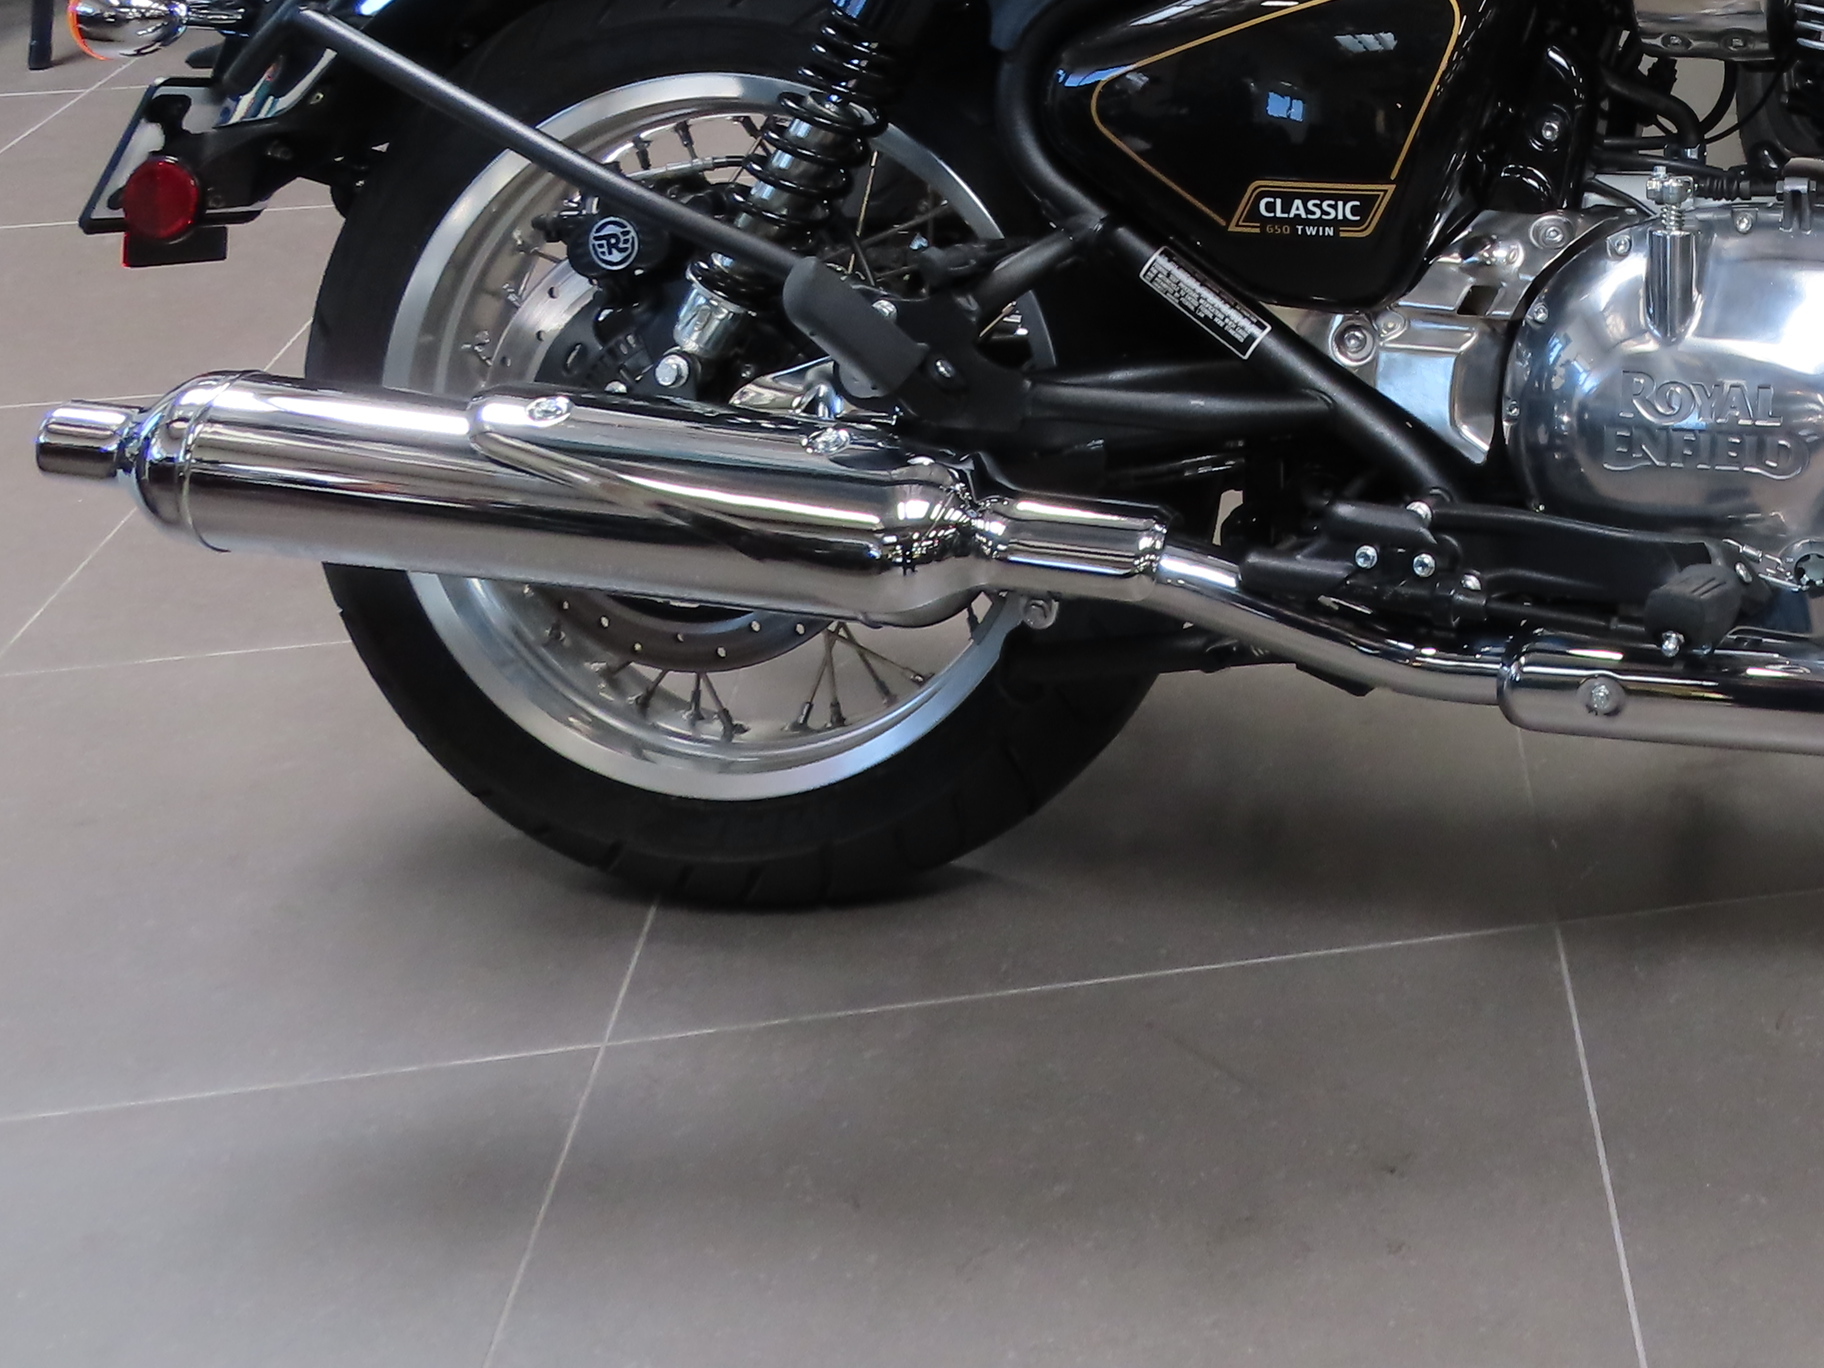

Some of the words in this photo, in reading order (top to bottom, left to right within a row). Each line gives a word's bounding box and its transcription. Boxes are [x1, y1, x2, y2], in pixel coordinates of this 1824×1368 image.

[1258, 197, 1361, 221] CLASSIC
[1266, 224, 1291, 234] 650
[1296, 225, 1335, 236] TWIN
[1618, 370, 1784, 426] ROYAL
[1603, 425, 1810, 481] ENFIELD
